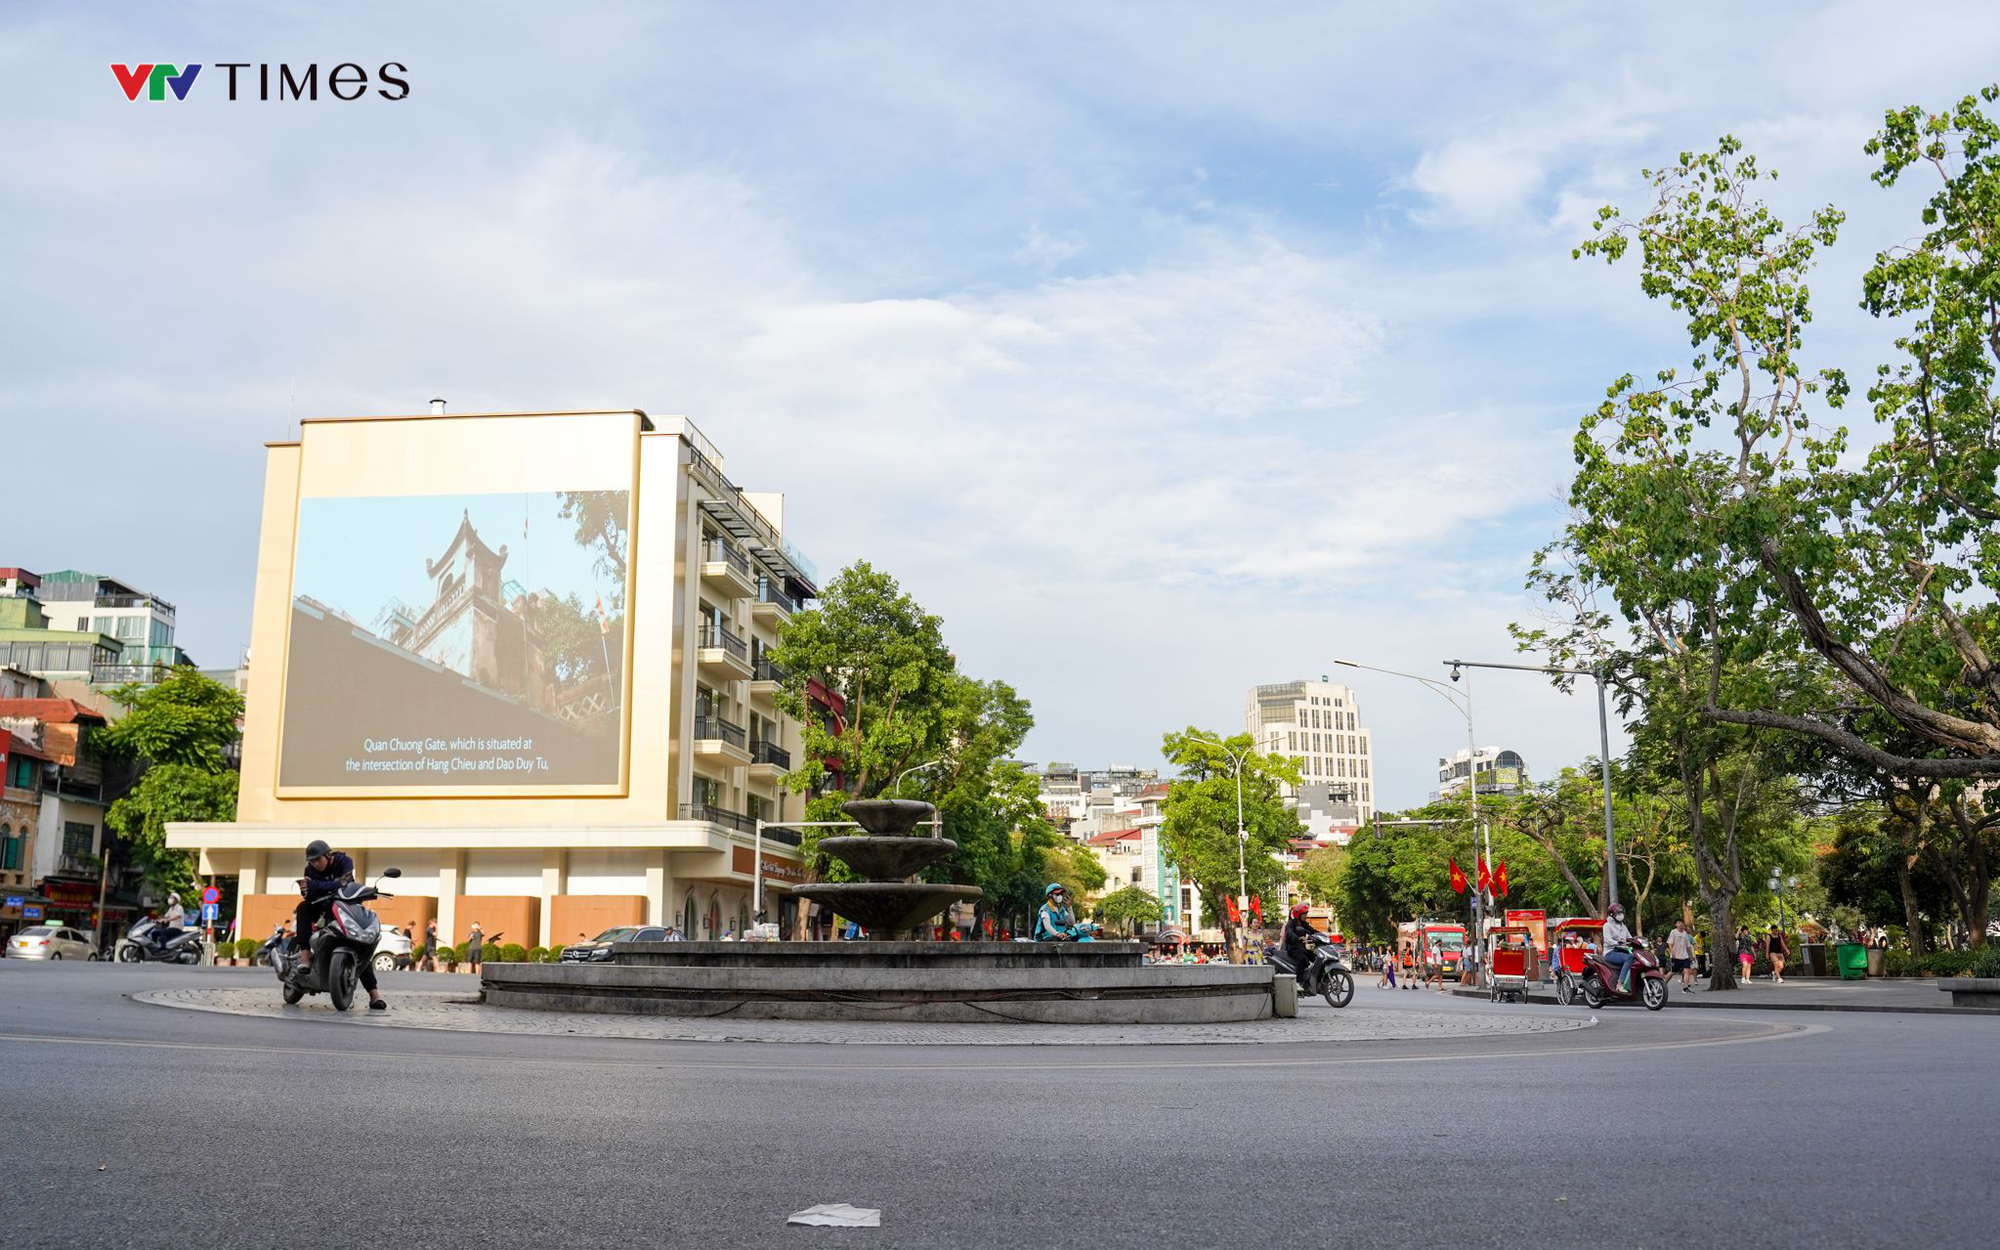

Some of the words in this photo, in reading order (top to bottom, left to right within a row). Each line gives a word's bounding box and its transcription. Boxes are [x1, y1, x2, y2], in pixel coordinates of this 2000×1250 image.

[364, 738, 387, 752] Quan
[390, 737, 422, 754] Chuong
[425, 738, 447, 751] Gate,
[450, 737, 476, 750] which
[478, 738, 485, 750] is
[486, 737, 521, 750] situated
[523, 738, 532, 750] at
[346, 757, 360, 771] the
[362, 758, 413, 771] intersection
[415, 757, 426, 770] of
[427, 758, 449, 774] Hang
[451, 757, 476, 770] Chieu
[478, 757, 494, 770] and
[496, 757, 514, 770] Dao
[516, 757, 533, 773] Duy
[536, 756, 549, 771] Tu,
